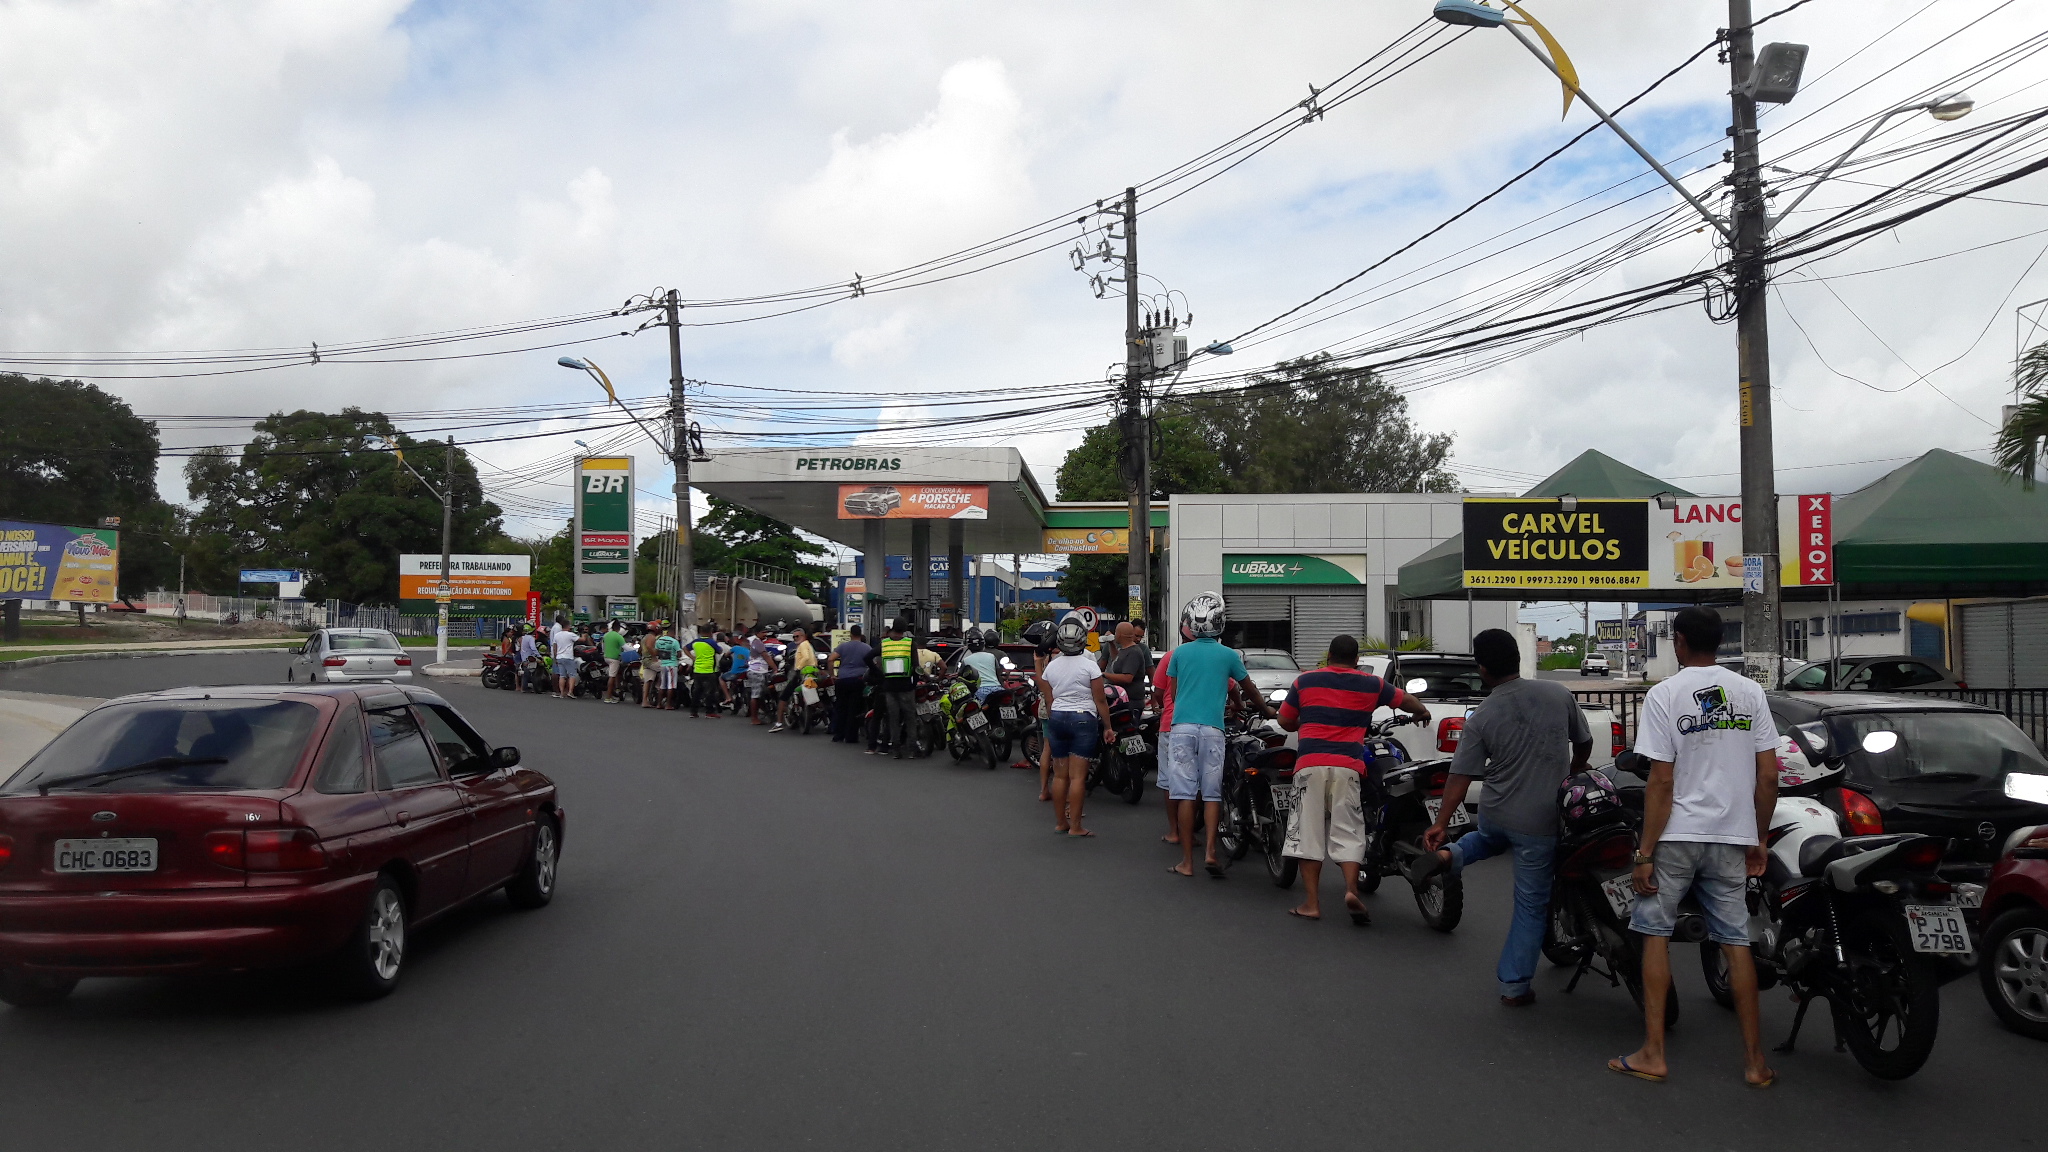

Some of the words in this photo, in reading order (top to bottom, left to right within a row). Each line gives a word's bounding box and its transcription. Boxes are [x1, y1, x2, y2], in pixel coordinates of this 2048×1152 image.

[796, 458, 901, 470] PETROBRAS
[586, 475, 624, 493] BR
[908, 494, 917, 504] 4
[918, 494, 972, 504] PORSCHE
[1673, 504, 1742, 524] LANC
[1502, 513, 1605, 534] CARVEL
[6, 530, 35, 541] NOSSO
[1808, 497, 1827, 582] XEROX
[1487, 533, 1621, 560] VEÍCULOS
[420, 561, 460, 571] PREFEIRA
[462, 562, 511, 572] TRABALHANDO
[1231, 561, 1287, 574] LUBRAX
[1470, 575, 1516, 585] 3621.2290
[1526, 575, 1578, 585] 99973.2290
[1589, 575, 1641, 585] 98106.8847
[418, 586, 462, 597] REQUAÇÃO
[464, 588, 472, 596] DA
[473, 588, 481, 596] AV.
[482, 588, 512, 596] CONTORNO
[1084, 611, 1093, 622] 0
[1597, 622, 1636, 643] QUALIDE
[1918, 934, 1966, 951] 2798
